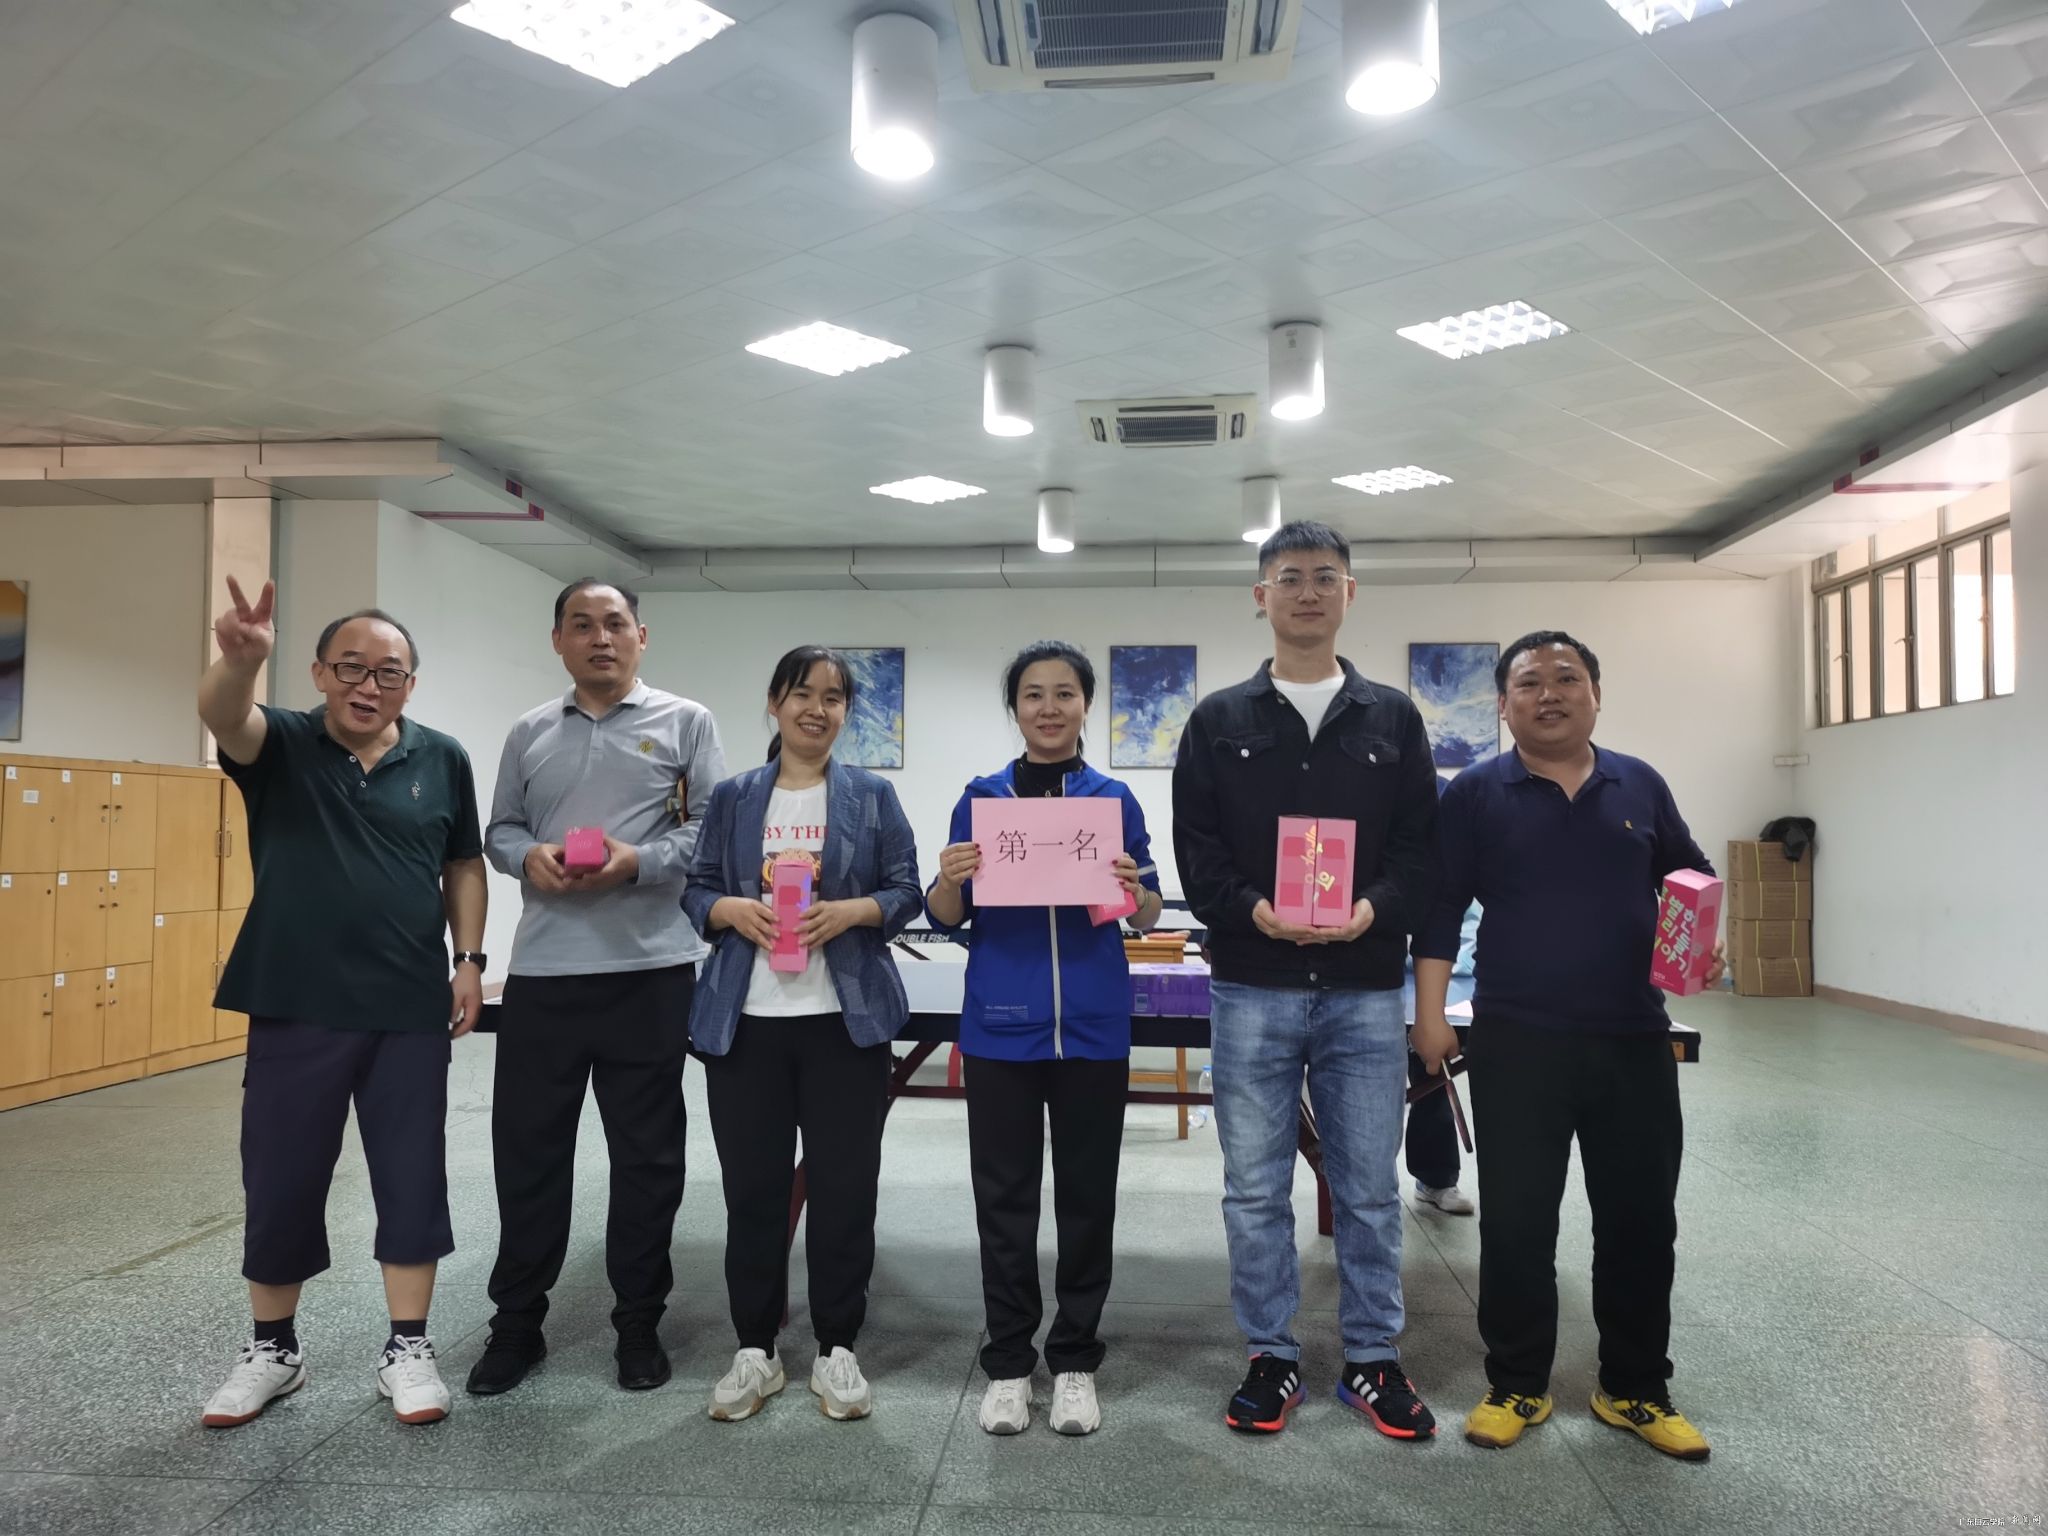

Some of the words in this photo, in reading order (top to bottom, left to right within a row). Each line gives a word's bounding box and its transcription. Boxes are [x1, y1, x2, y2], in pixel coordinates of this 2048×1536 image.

[764, 825, 786, 840] BY
[995, 828, 1098, 864] 第一名
[891, 933, 927, 943] OUBLE
[927, 933, 950, 943] FISH
